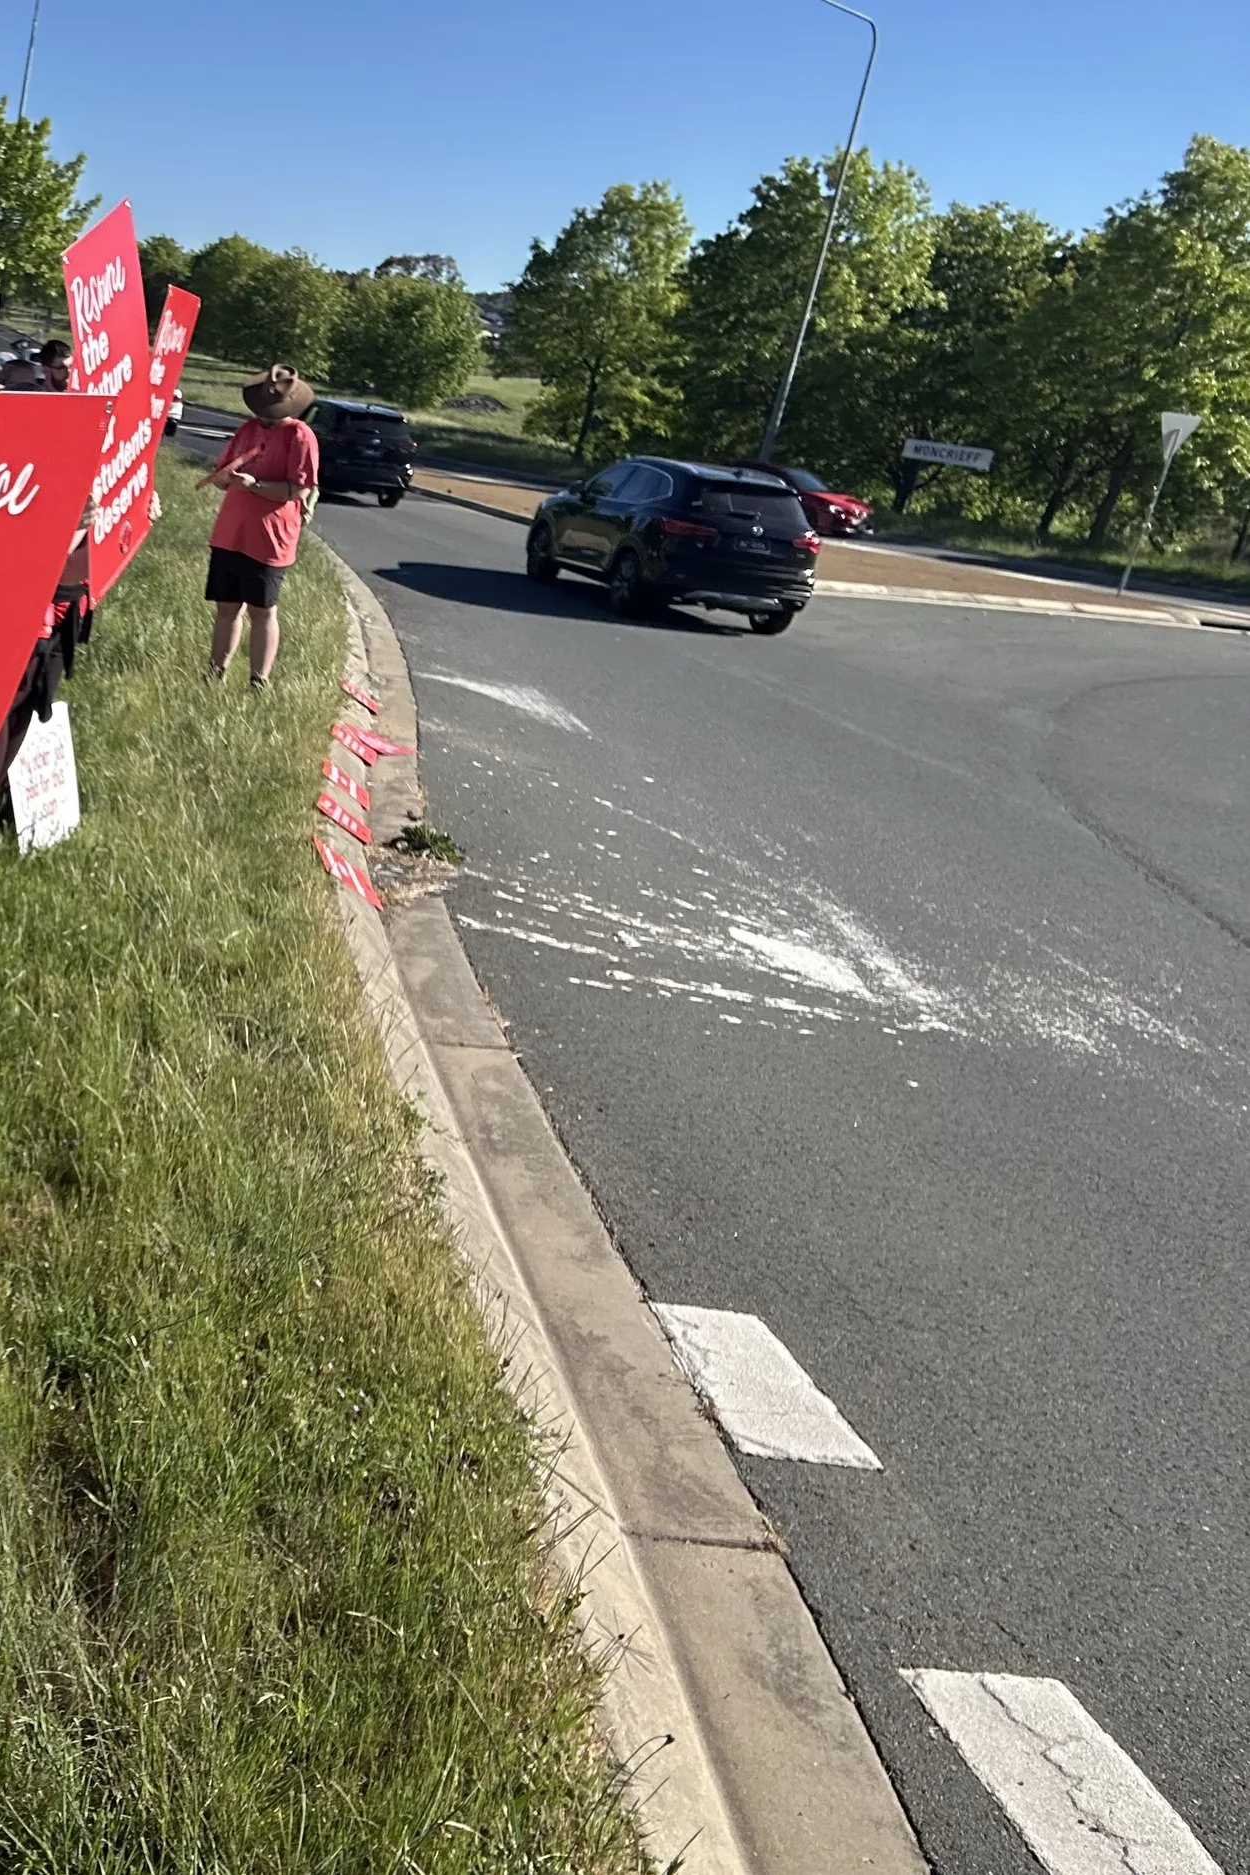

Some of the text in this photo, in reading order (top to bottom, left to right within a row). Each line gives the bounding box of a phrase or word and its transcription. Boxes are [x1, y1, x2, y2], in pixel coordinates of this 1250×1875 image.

[82, 331, 109, 376] the
[92, 417, 152, 506] students
[913, 445, 982, 462] MONCRIEFF
[93, 462, 148, 545] deserve
